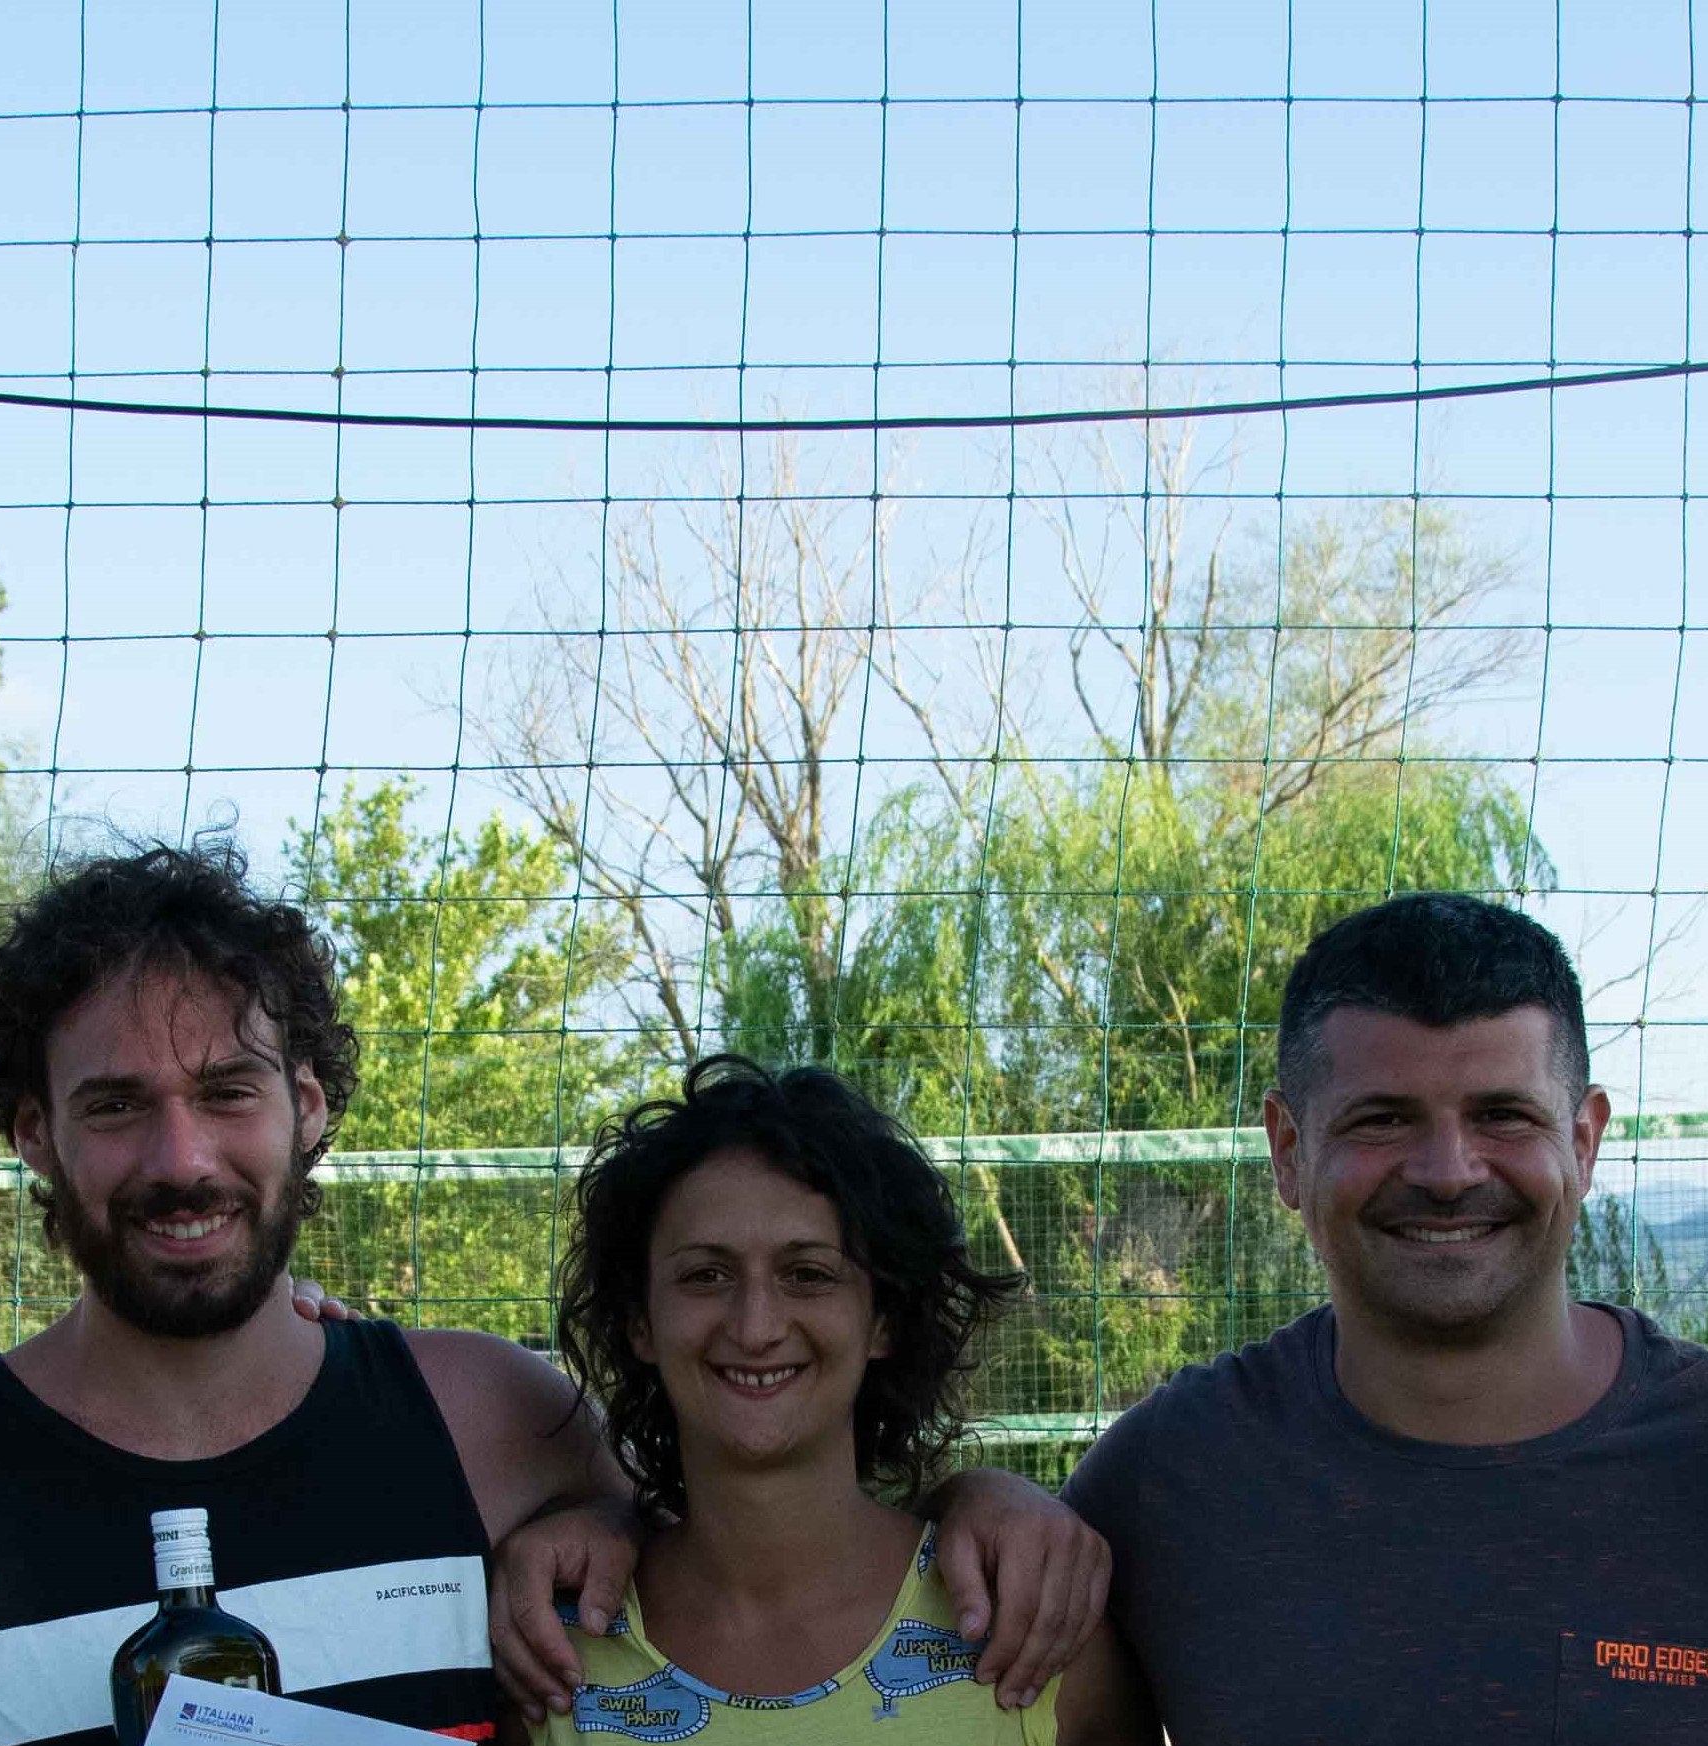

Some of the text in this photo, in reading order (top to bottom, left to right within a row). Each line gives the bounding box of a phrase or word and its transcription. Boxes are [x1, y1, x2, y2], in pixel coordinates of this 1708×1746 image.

[376, 1585, 418, 1600] PACIFIC
[894, 1638, 950, 1657] PARTY
[1611, 1666, 1697, 1686] INDUSTRIES
[598, 1694, 646, 1713] SWIM
[198, 1706, 254, 1727] ITALIANA
[624, 1709, 681, 1727] PARTY
